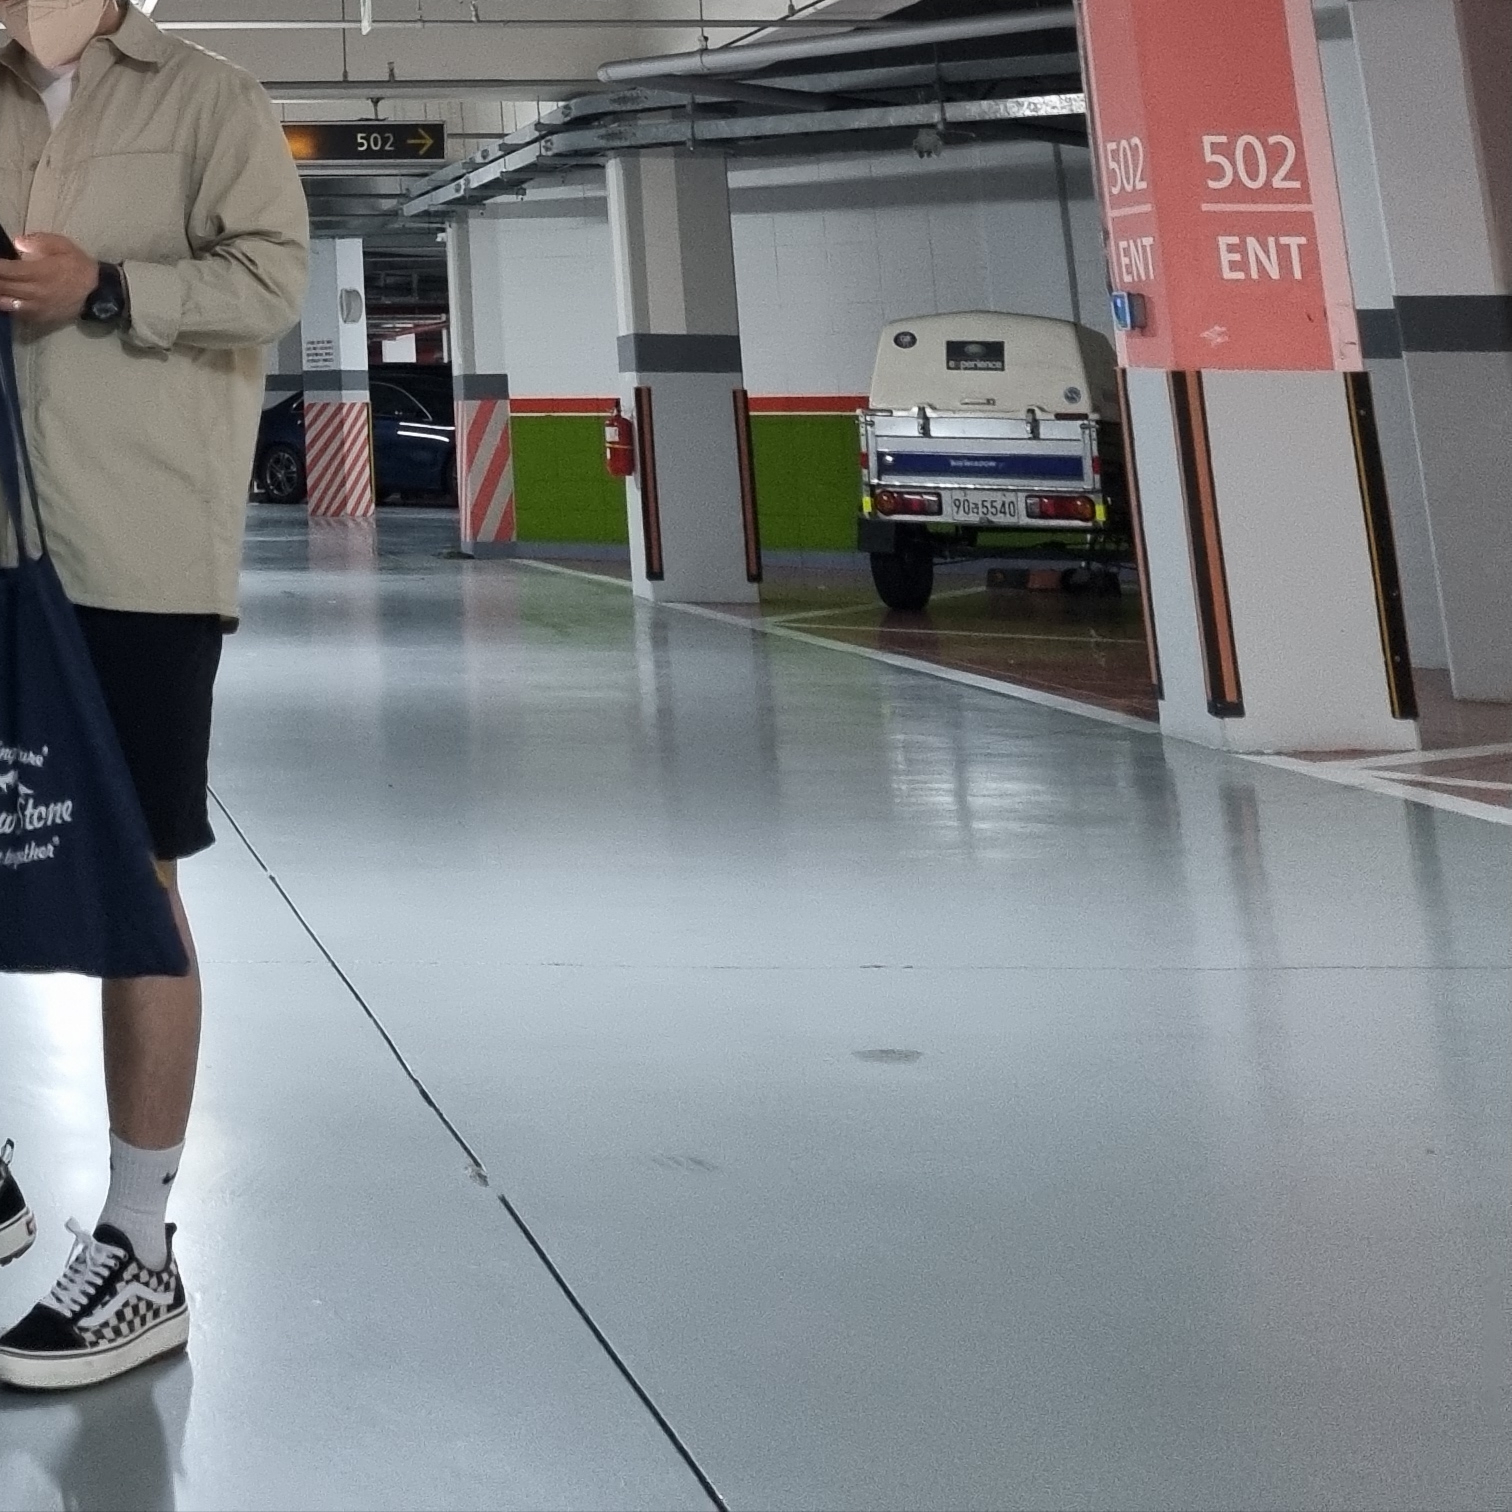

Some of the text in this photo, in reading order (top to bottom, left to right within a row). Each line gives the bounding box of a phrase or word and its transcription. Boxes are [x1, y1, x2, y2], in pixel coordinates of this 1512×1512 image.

[356, 133, 395, 151] 502
[1201, 134, 1302, 190] 502
[1106, 137, 1148, 195] 502
[1118, 236, 1156, 283] ENT
[1217, 236, 1307, 281] ENT
